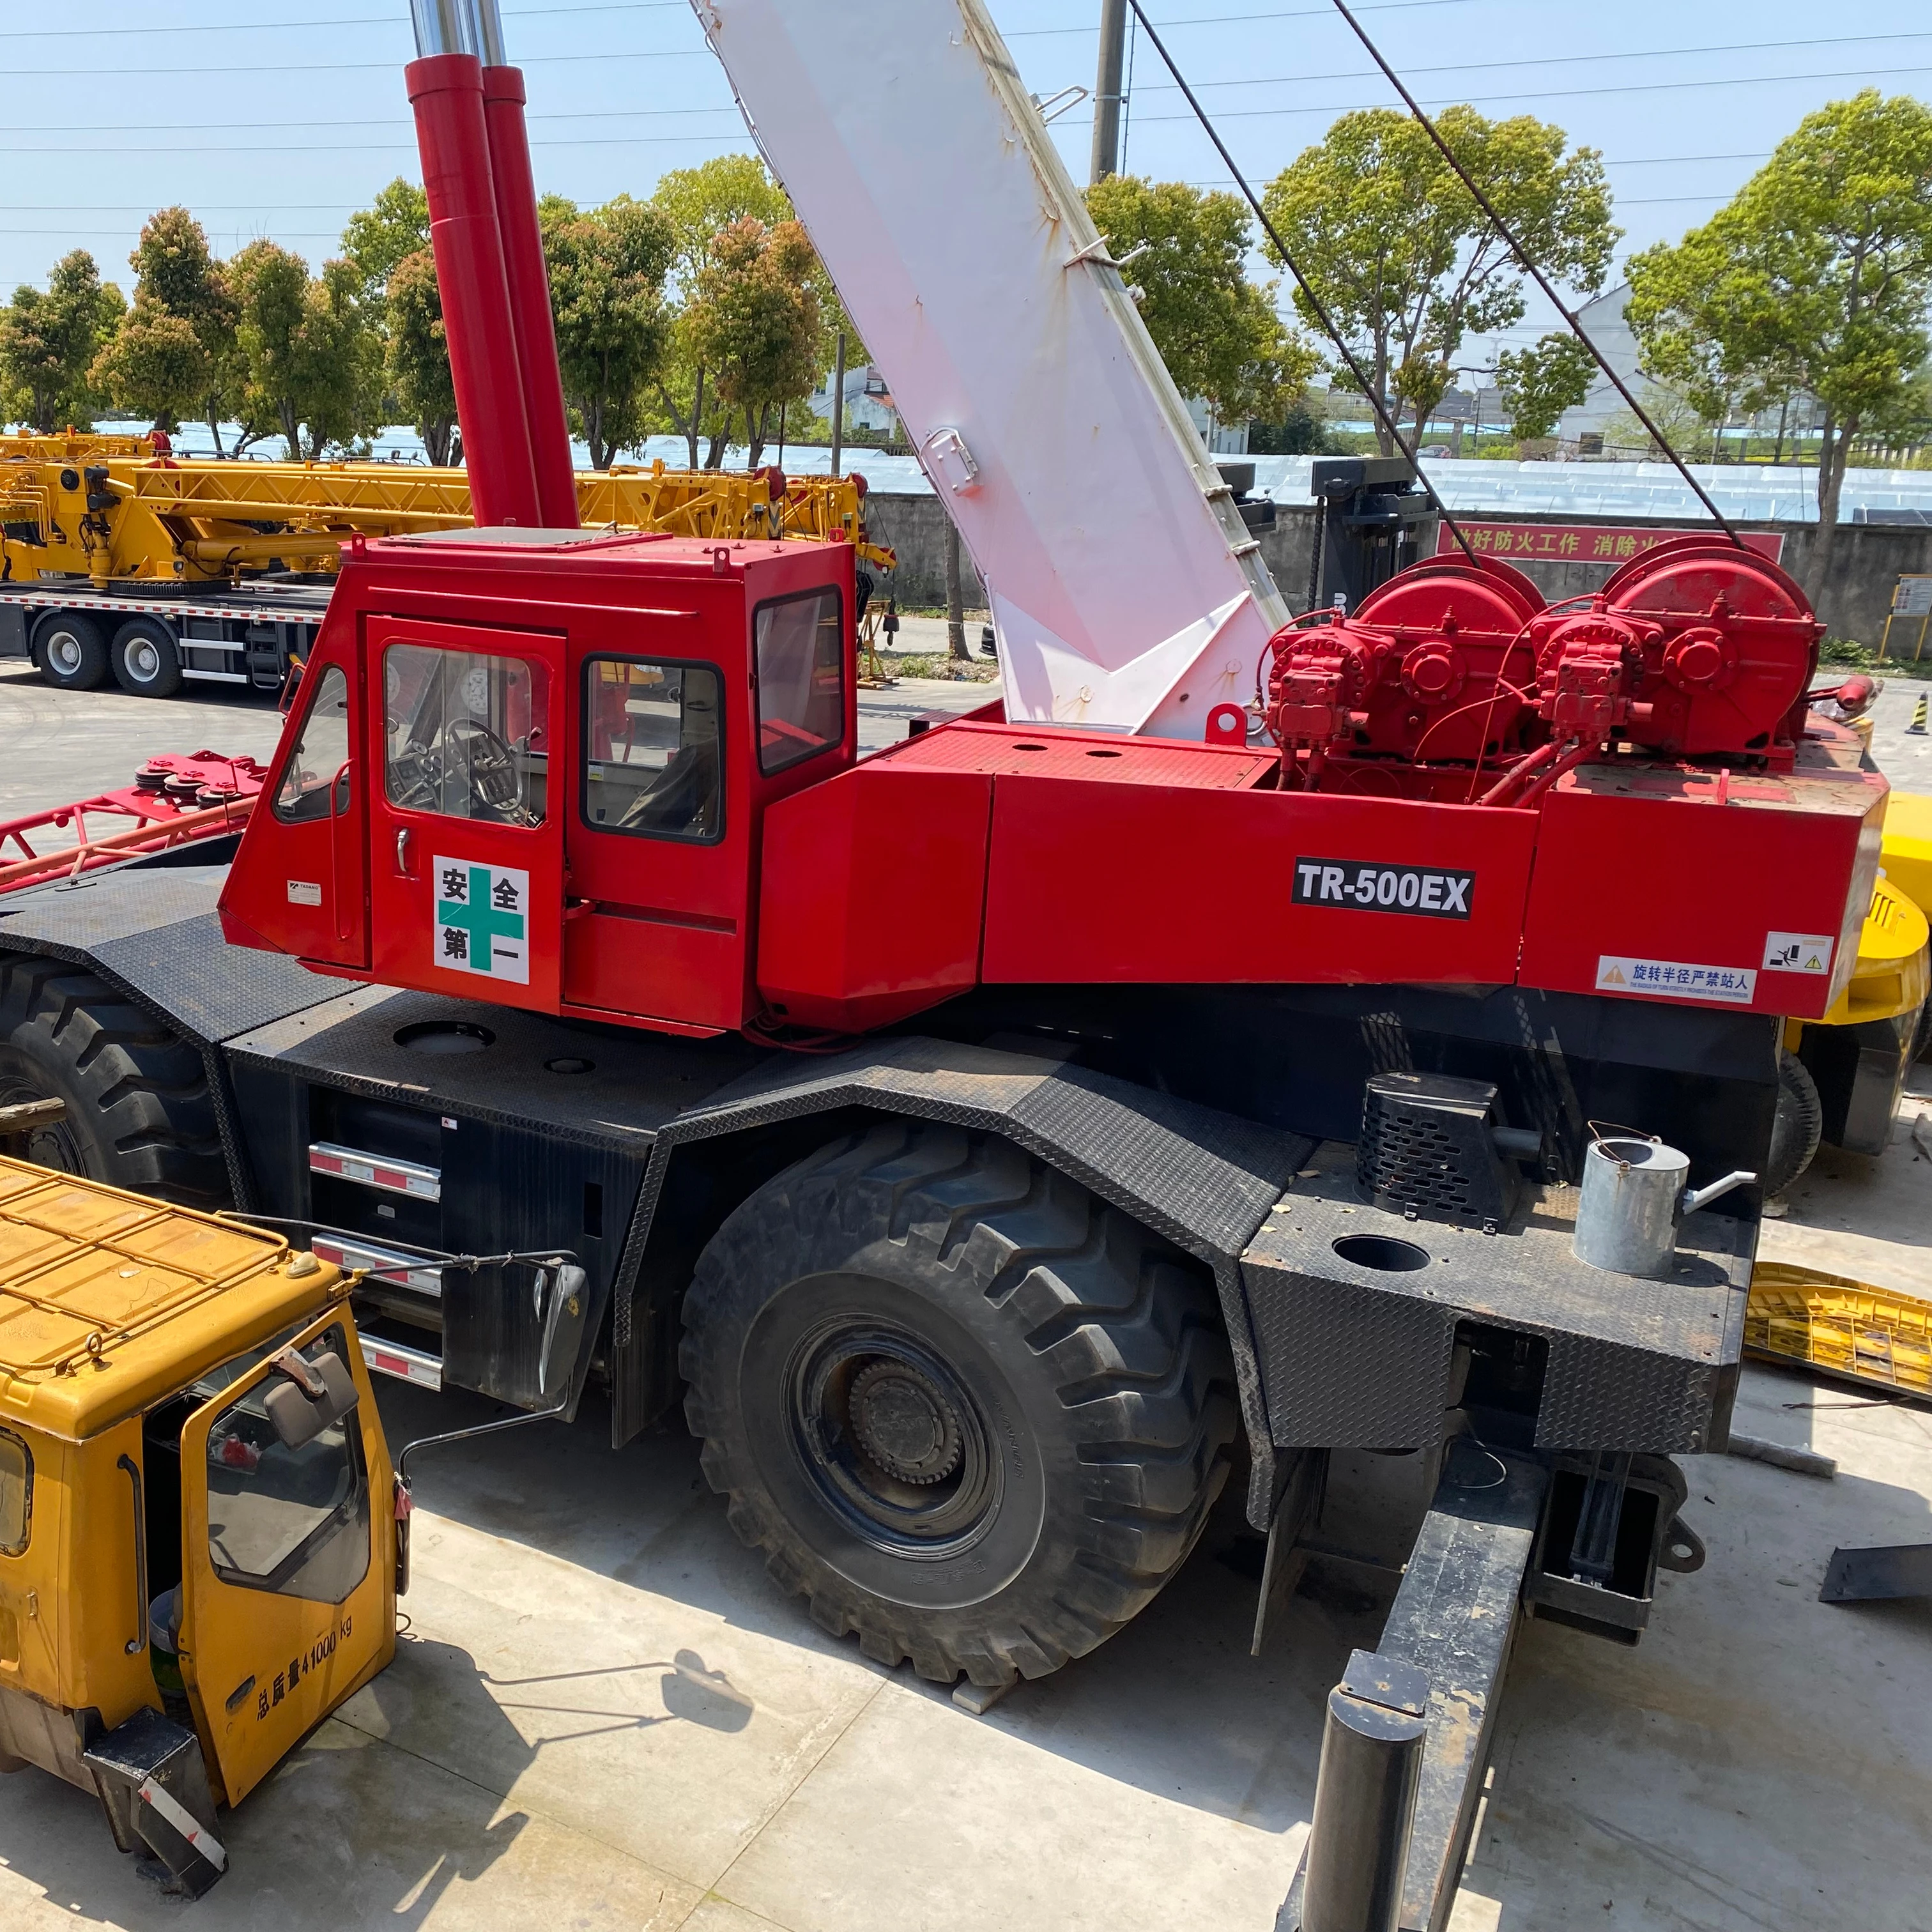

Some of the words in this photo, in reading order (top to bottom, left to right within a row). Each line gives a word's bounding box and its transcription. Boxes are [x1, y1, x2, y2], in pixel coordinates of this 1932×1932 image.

[1298, 864, 1471, 912] TR-500EX
[1632, 964, 1749, 990] 旋转半径严禁站人
[340, 1615, 352, 1641] kg
